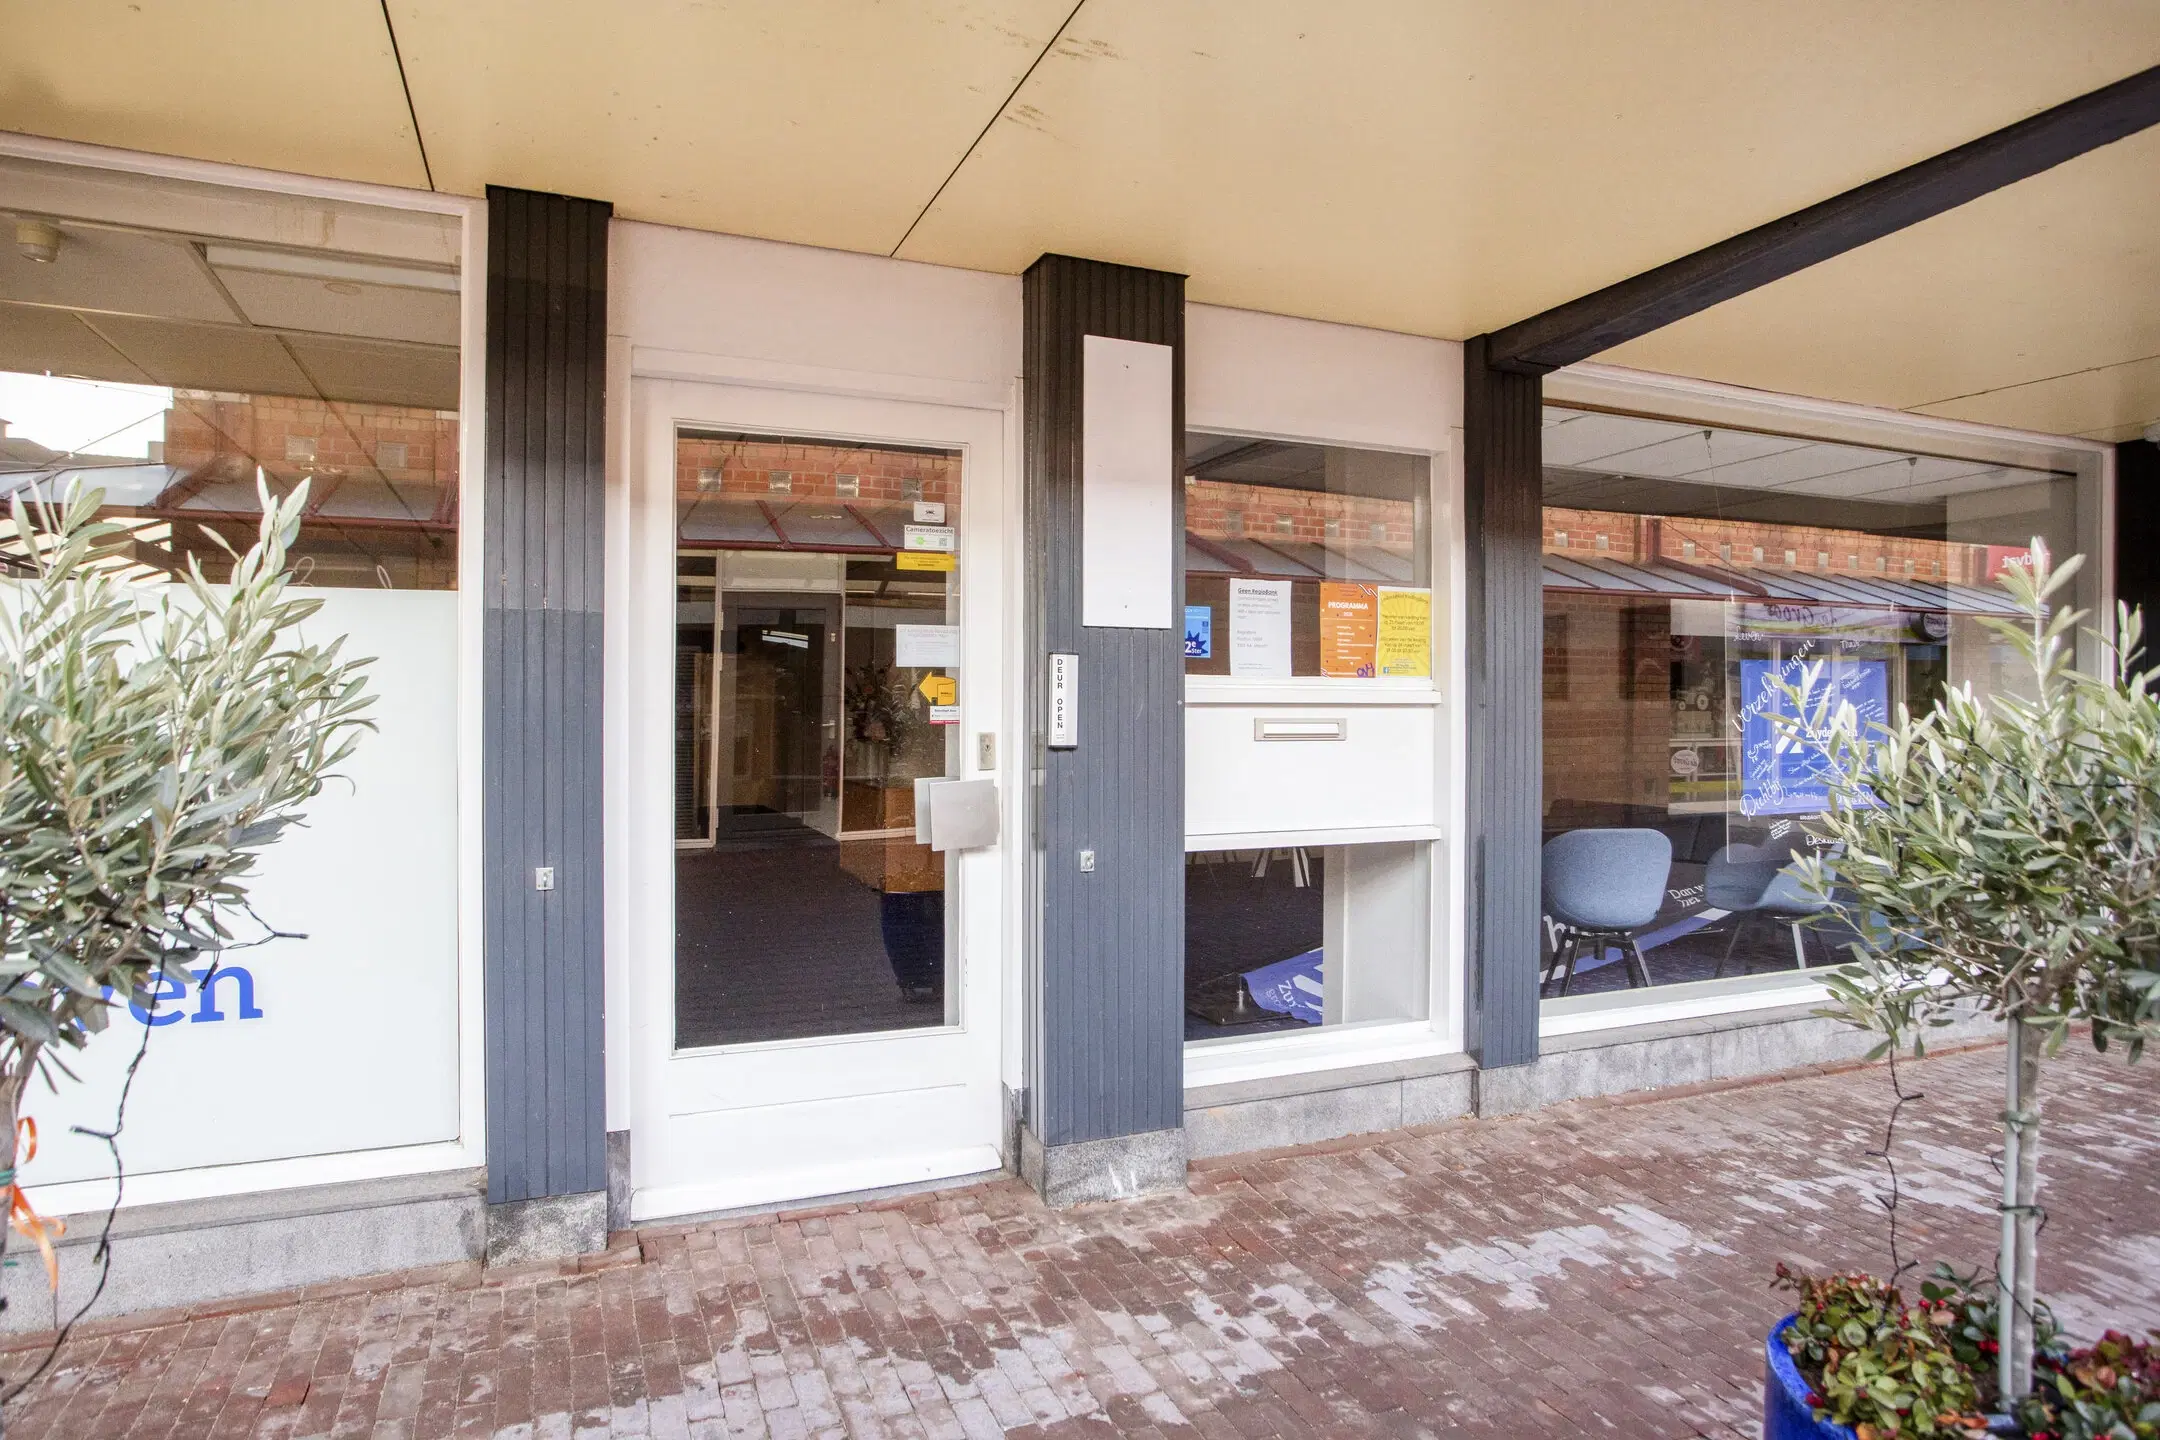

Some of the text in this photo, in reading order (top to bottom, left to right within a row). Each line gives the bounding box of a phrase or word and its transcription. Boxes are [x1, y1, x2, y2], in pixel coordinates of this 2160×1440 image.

[905, 526, 954, 534] Cameratoezicht
[1237, 587, 1251, 595] Geen
[1328, 601, 1369, 610] PROGRAMMA
[1668, 888, 1696, 899] Dan
